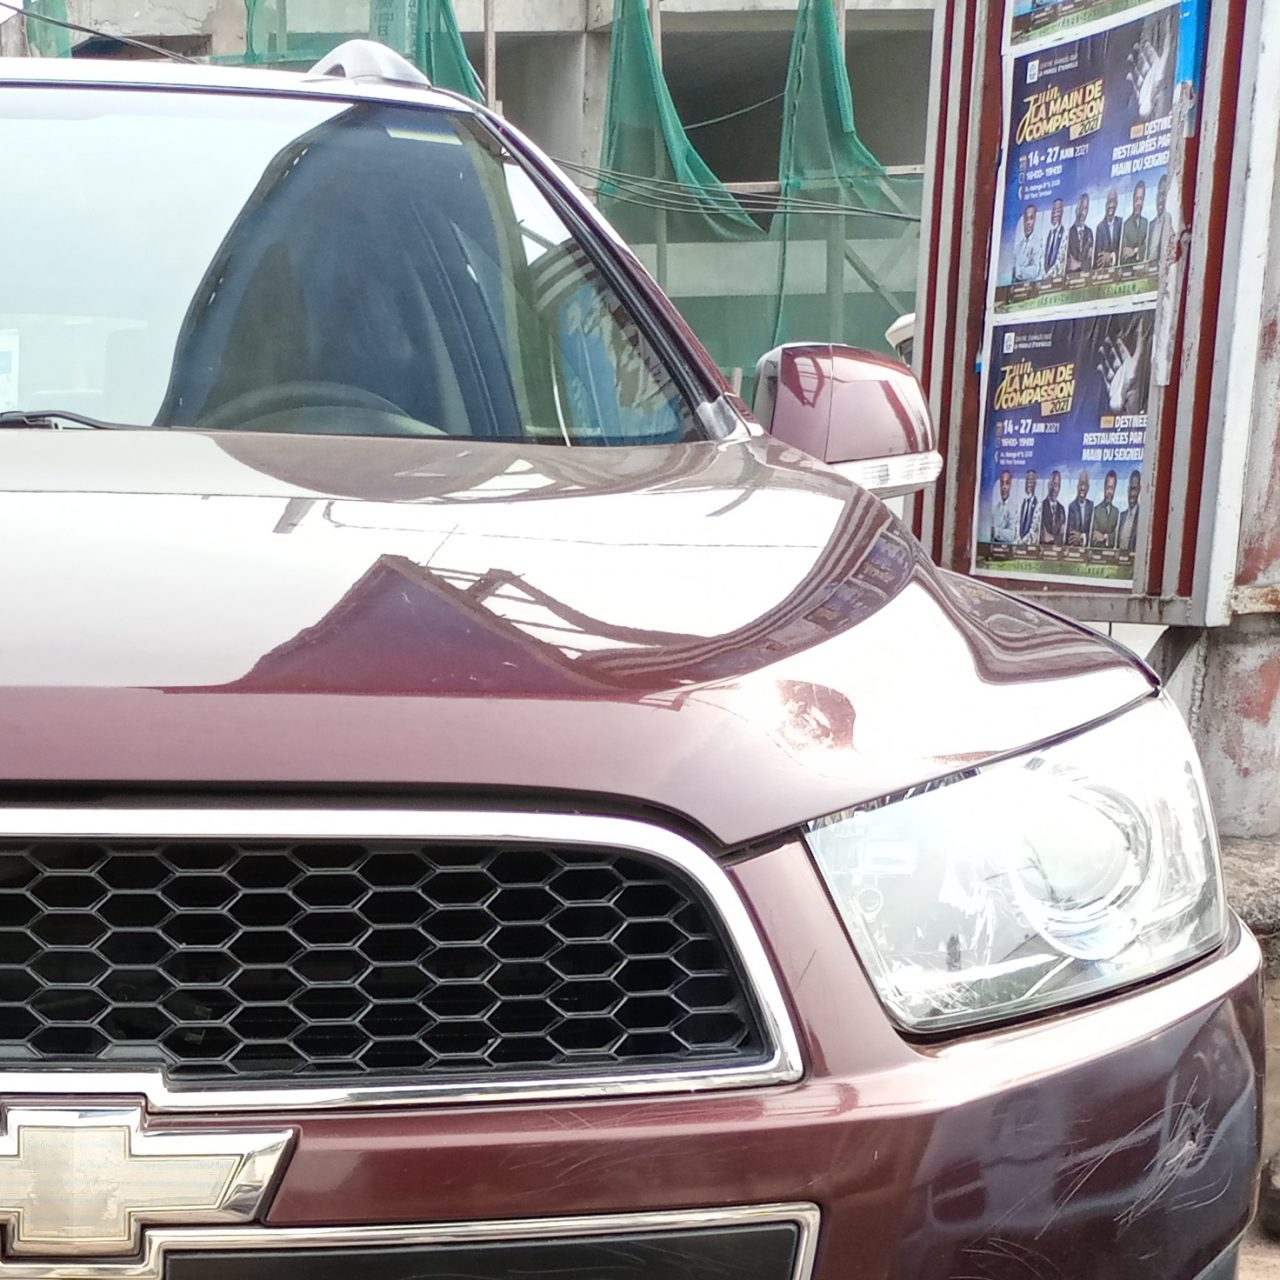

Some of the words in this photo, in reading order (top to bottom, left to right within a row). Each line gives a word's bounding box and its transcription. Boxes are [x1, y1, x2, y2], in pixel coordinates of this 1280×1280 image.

[1030, 102, 1046, 124] LA
[1048, 86, 1084, 117] MAIN
[1085, 79, 1104, 102] DE
[1025, 96, 1105, 142] COMPASSION
[1078, 117, 1099, 136] 2021
[1028, 150, 1039, 167] 14
[1046, 146, 1059, 164] 27
[1111, 160, 1132, 178] MAIN
[1132, 157, 1143, 173] DU
[1006, 374, 1020, 393] LA
[1022, 368, 1056, 390] MAIN
[1056, 363, 1075, 381] DE
[1001, 379, 1076, 410] COMPASSION
[1049, 400, 1069, 413] 2021
[1003, 419, 1013, 435] 14
[1019, 418, 1032, 434] 27
[1082, 428, 1129, 446] RESTAURÉES
[1129, 431, 1143, 445] PAR
[1081, 448, 1102, 461] MAIN
[1103, 448, 1114, 461] DU
